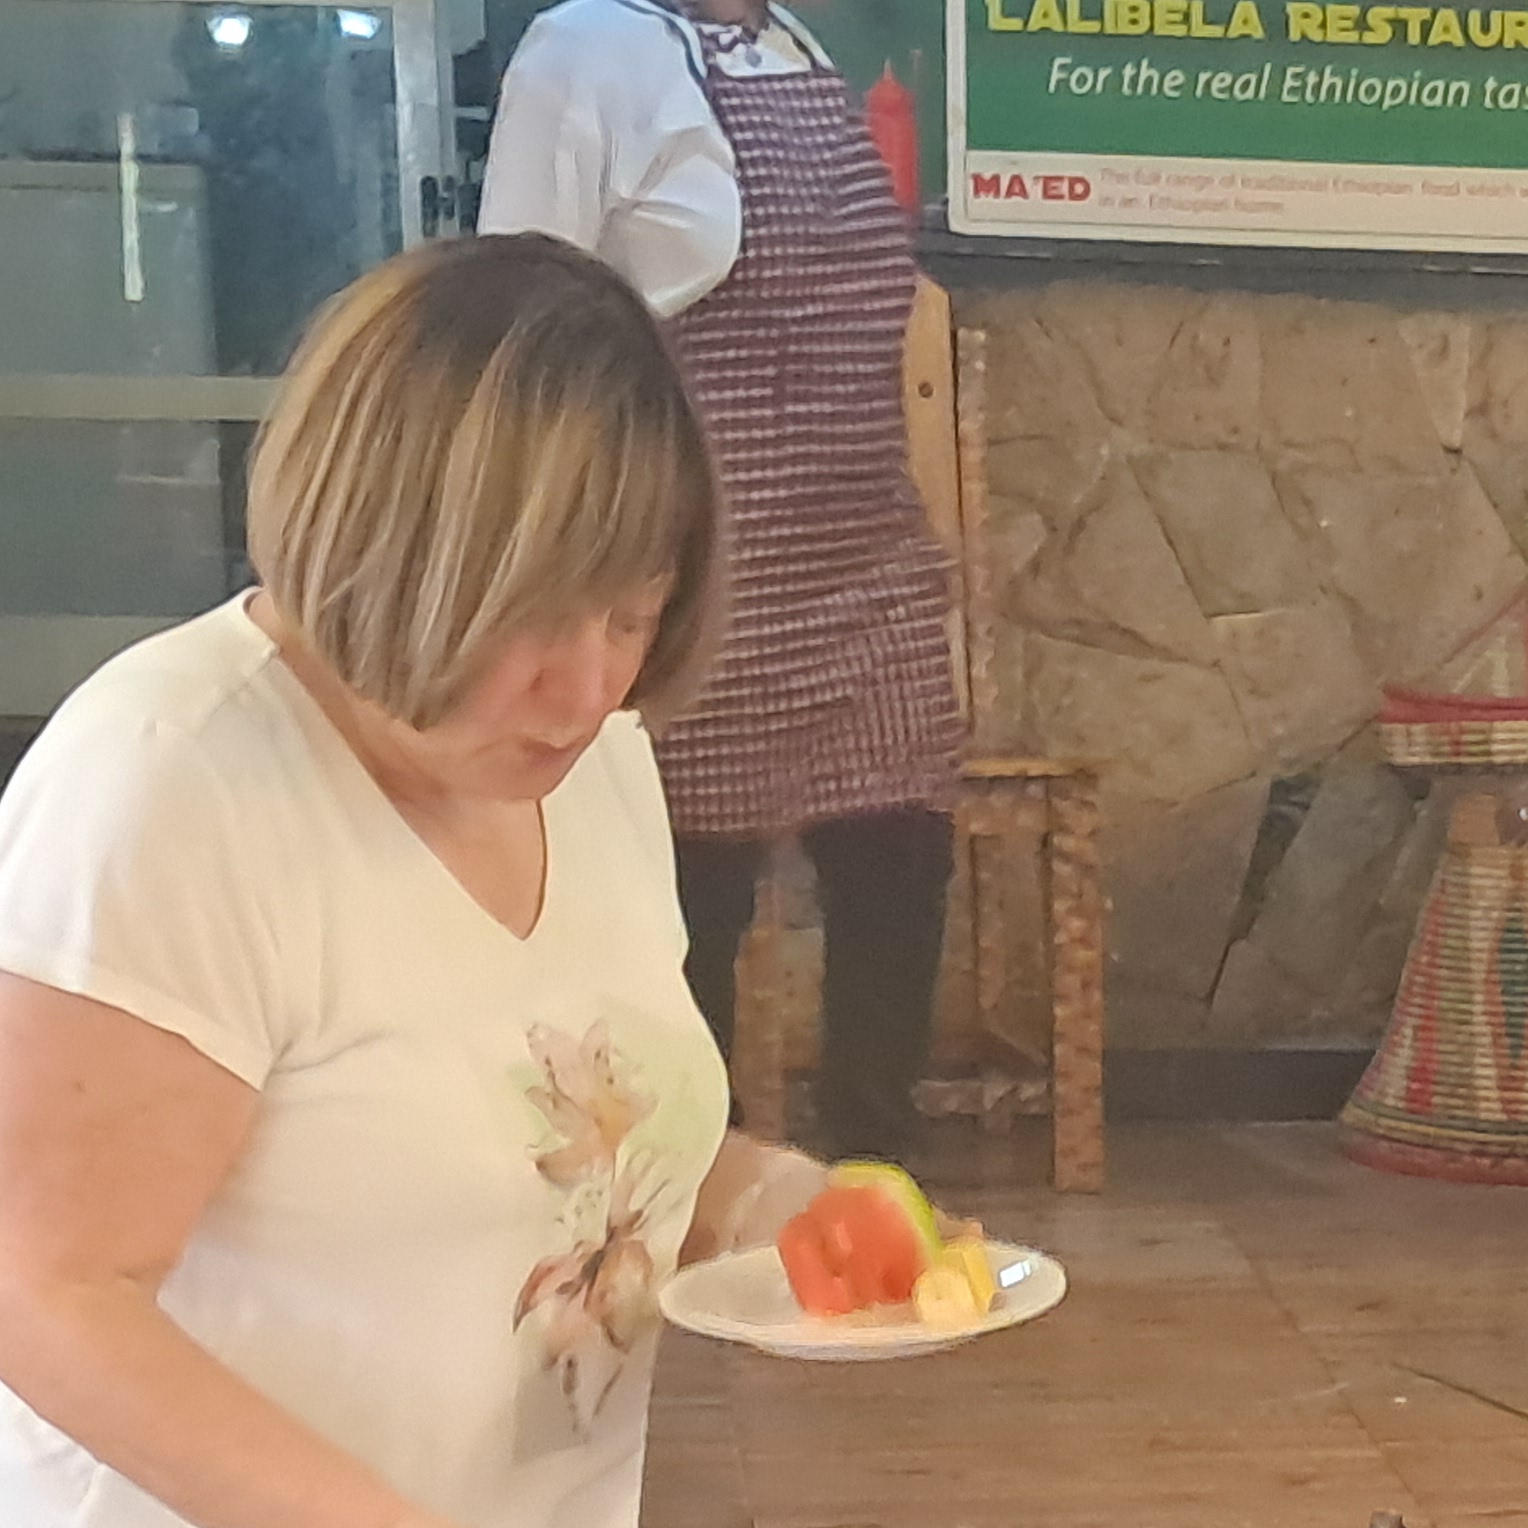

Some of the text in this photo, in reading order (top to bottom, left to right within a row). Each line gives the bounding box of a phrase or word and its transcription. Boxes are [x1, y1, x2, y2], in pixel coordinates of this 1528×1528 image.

[984, 0, 1265, 39] LALIBELA
[1049, 57, 1113, 96] For
[1121, 58, 1186, 98] the
[1195, 63, 1272, 101] real
[1281, 65, 1470, 111] Ethiopian
